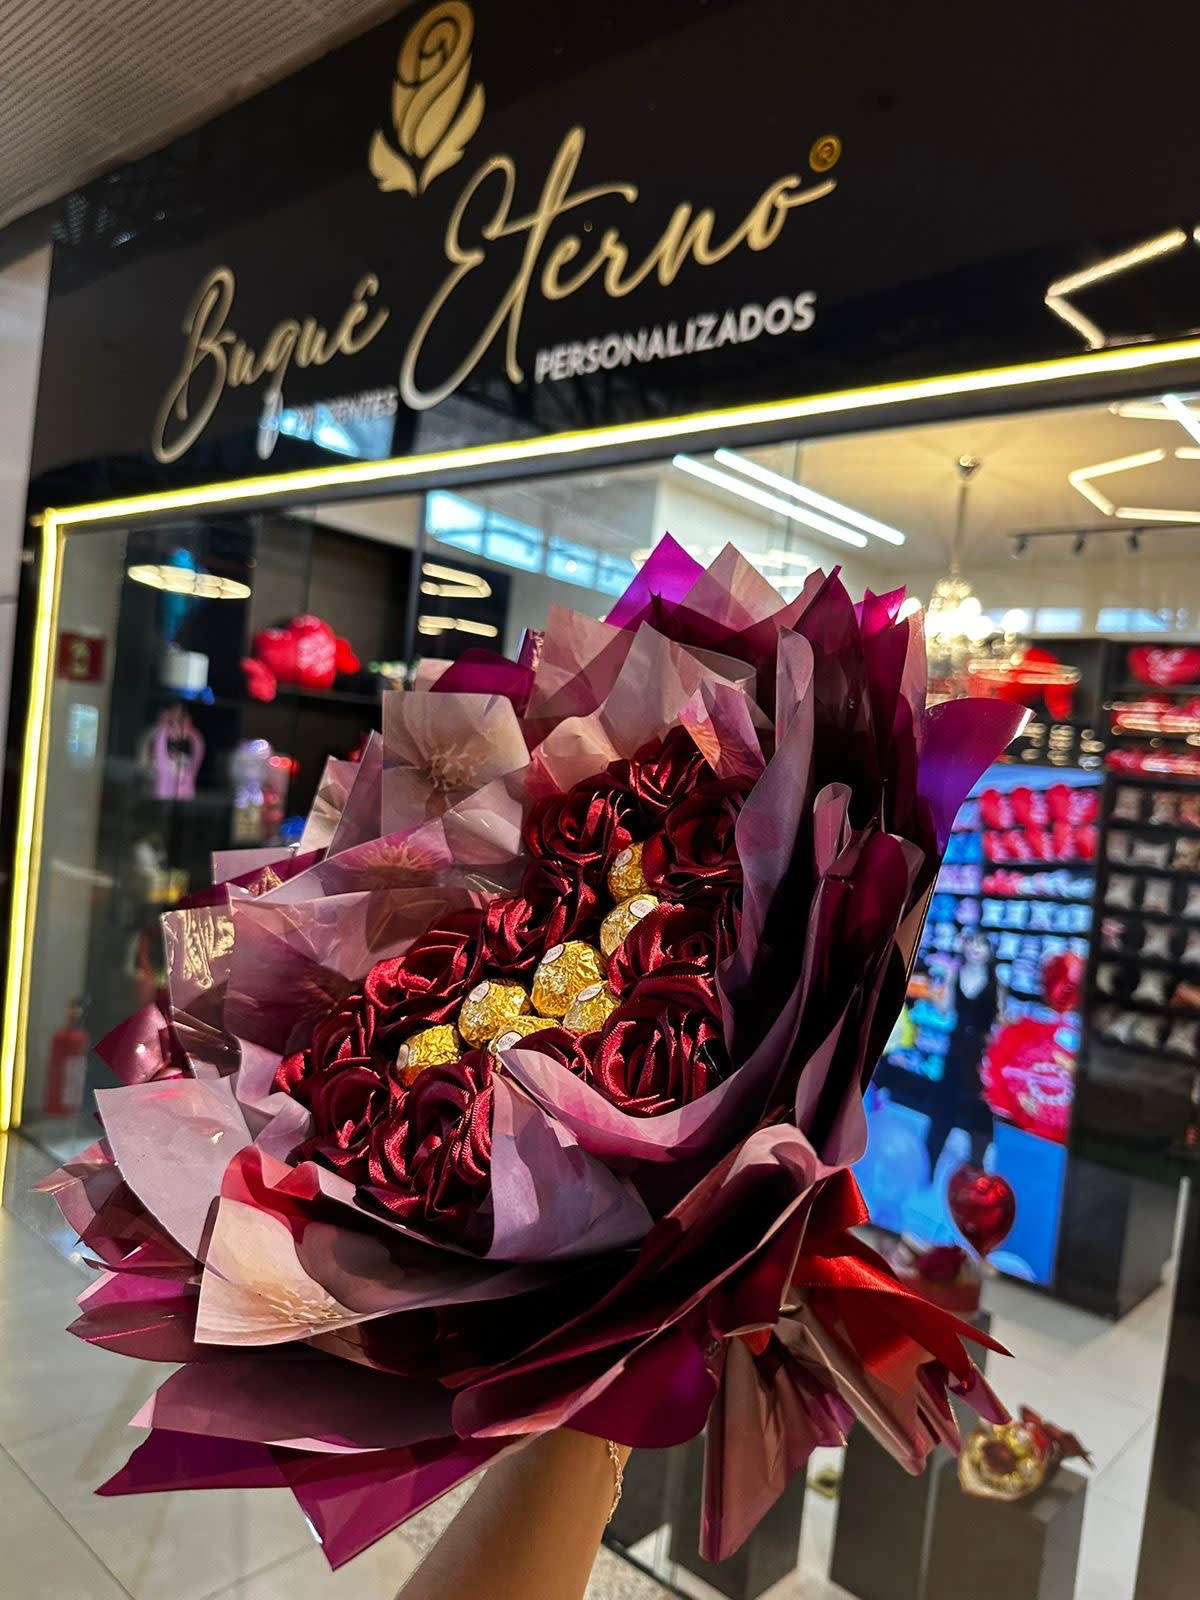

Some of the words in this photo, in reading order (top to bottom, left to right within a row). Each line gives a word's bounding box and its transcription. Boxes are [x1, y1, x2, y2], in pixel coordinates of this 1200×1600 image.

[152, 265, 391, 464] Buquê
[400, 125, 838, 411] Eterno
[534, 291, 817, 384] PERSONALIZADOS
